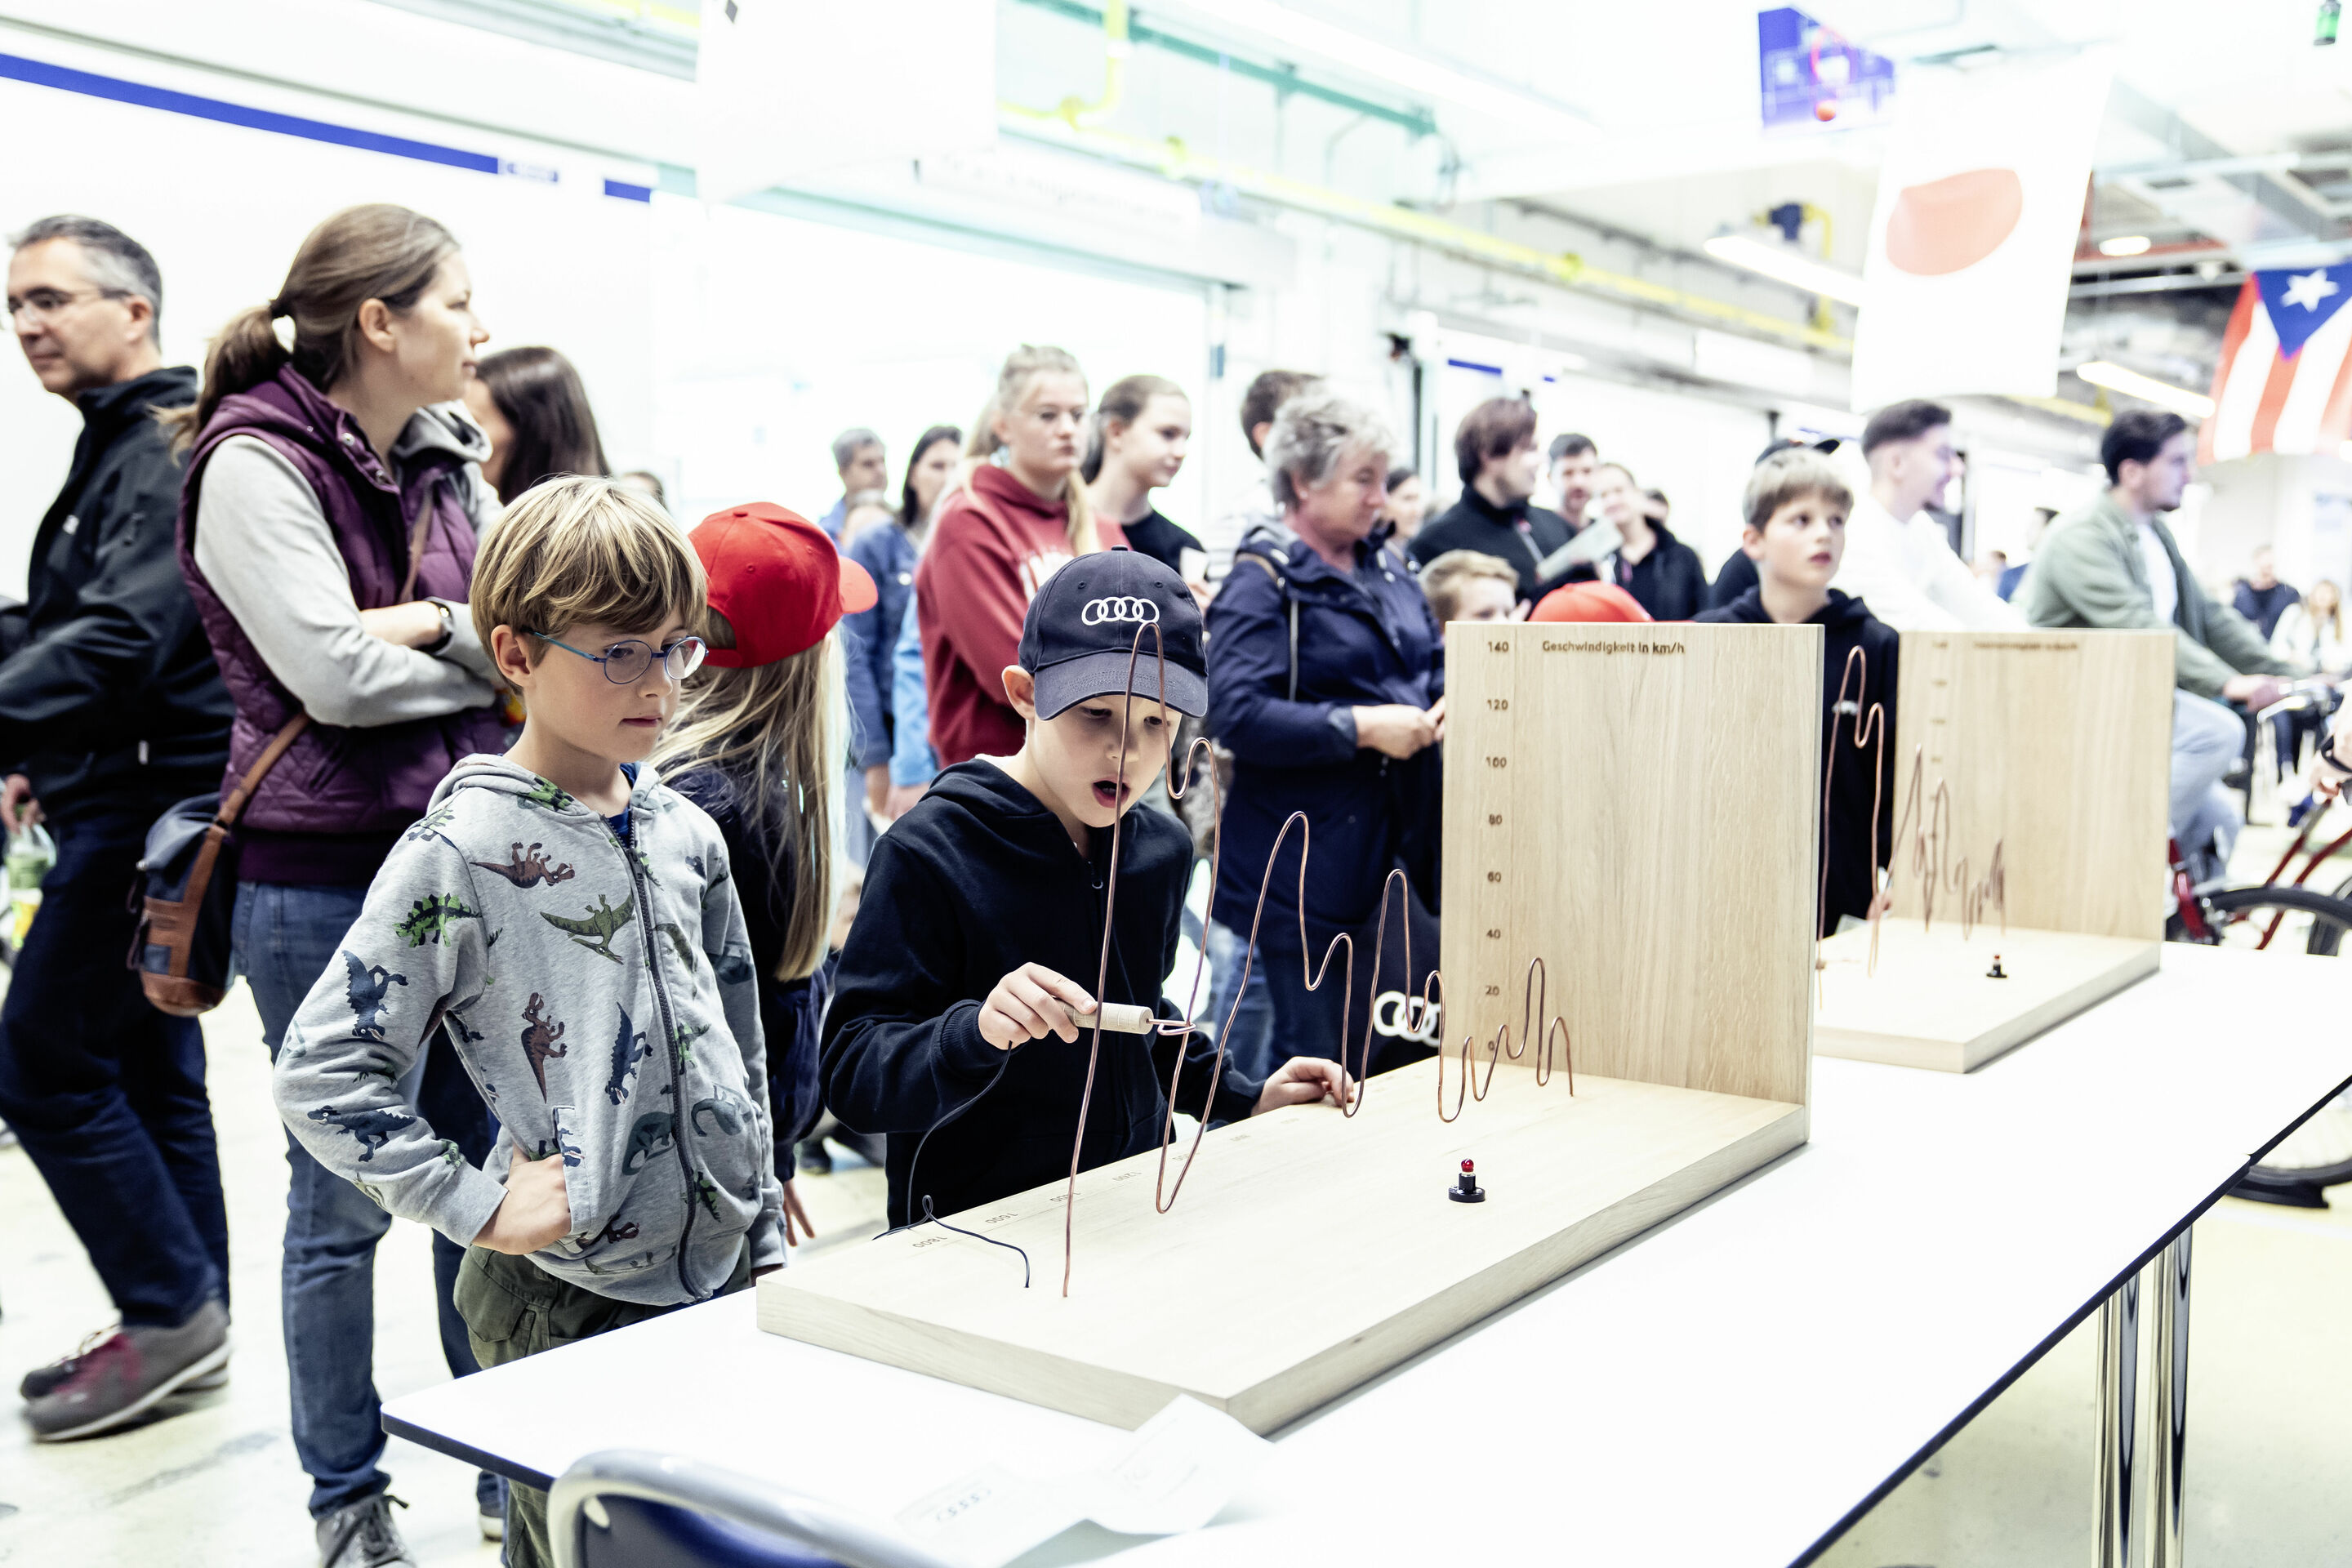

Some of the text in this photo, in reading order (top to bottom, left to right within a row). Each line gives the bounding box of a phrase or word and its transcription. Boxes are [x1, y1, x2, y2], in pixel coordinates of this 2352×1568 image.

[1488, 641, 1509, 653] 140
[1543, 640, 1635, 654] Geschwindigkeit
[1652, 642, 1685, 654] km/h
[1487, 699, 1508, 710] 120
[1486, 756, 1507, 768] 100
[1489, 814, 1503, 826] 80
[1487, 871, 1502, 883] 60
[1486, 929, 1501, 940] 40
[1486, 985, 1500, 996] 20
[1049, 1192, 1081, 1202] 100
[985, 1212, 1018, 1225] 1600
[911, 1236, 948, 1249] 1800
